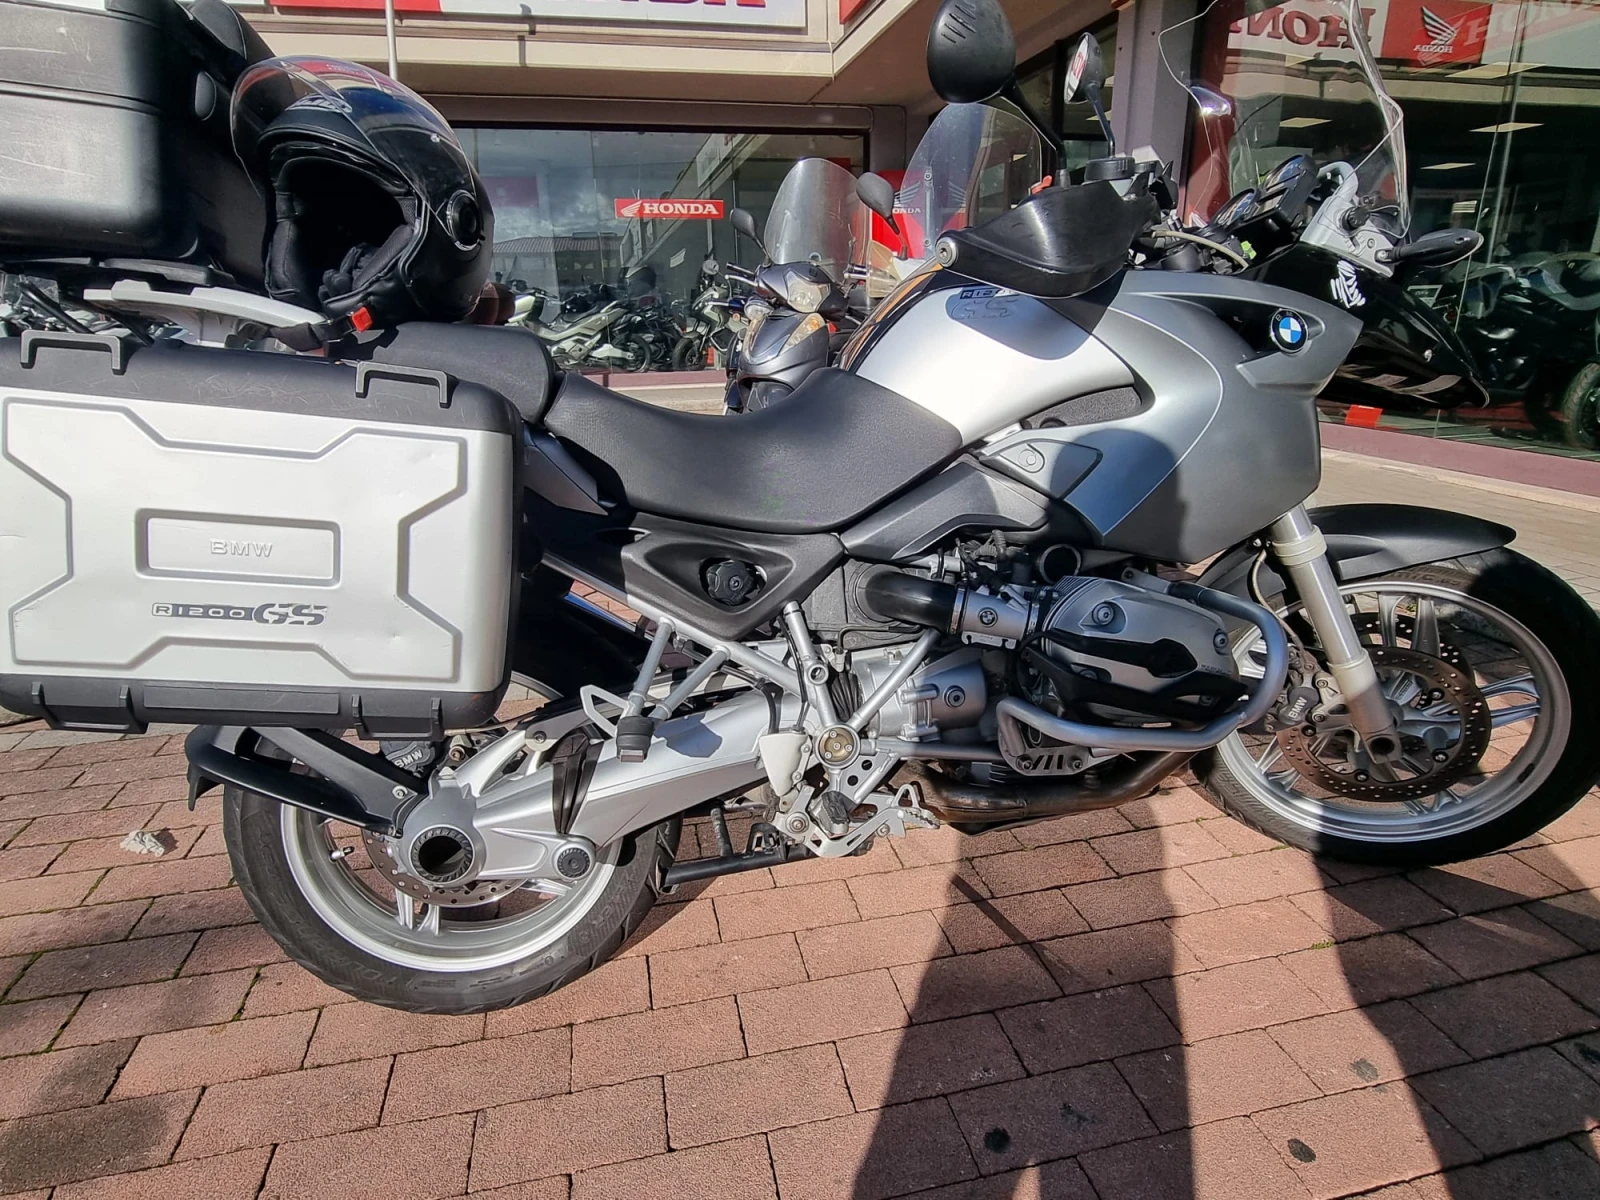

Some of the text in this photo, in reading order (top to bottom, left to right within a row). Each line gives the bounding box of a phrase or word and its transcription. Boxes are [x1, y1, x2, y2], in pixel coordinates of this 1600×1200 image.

[643, 203, 719, 215] HONDA
[210, 539, 273, 558] BMW
[1288, 696, 1307, 719] BMW
[394, 749, 423, 768] BMW
